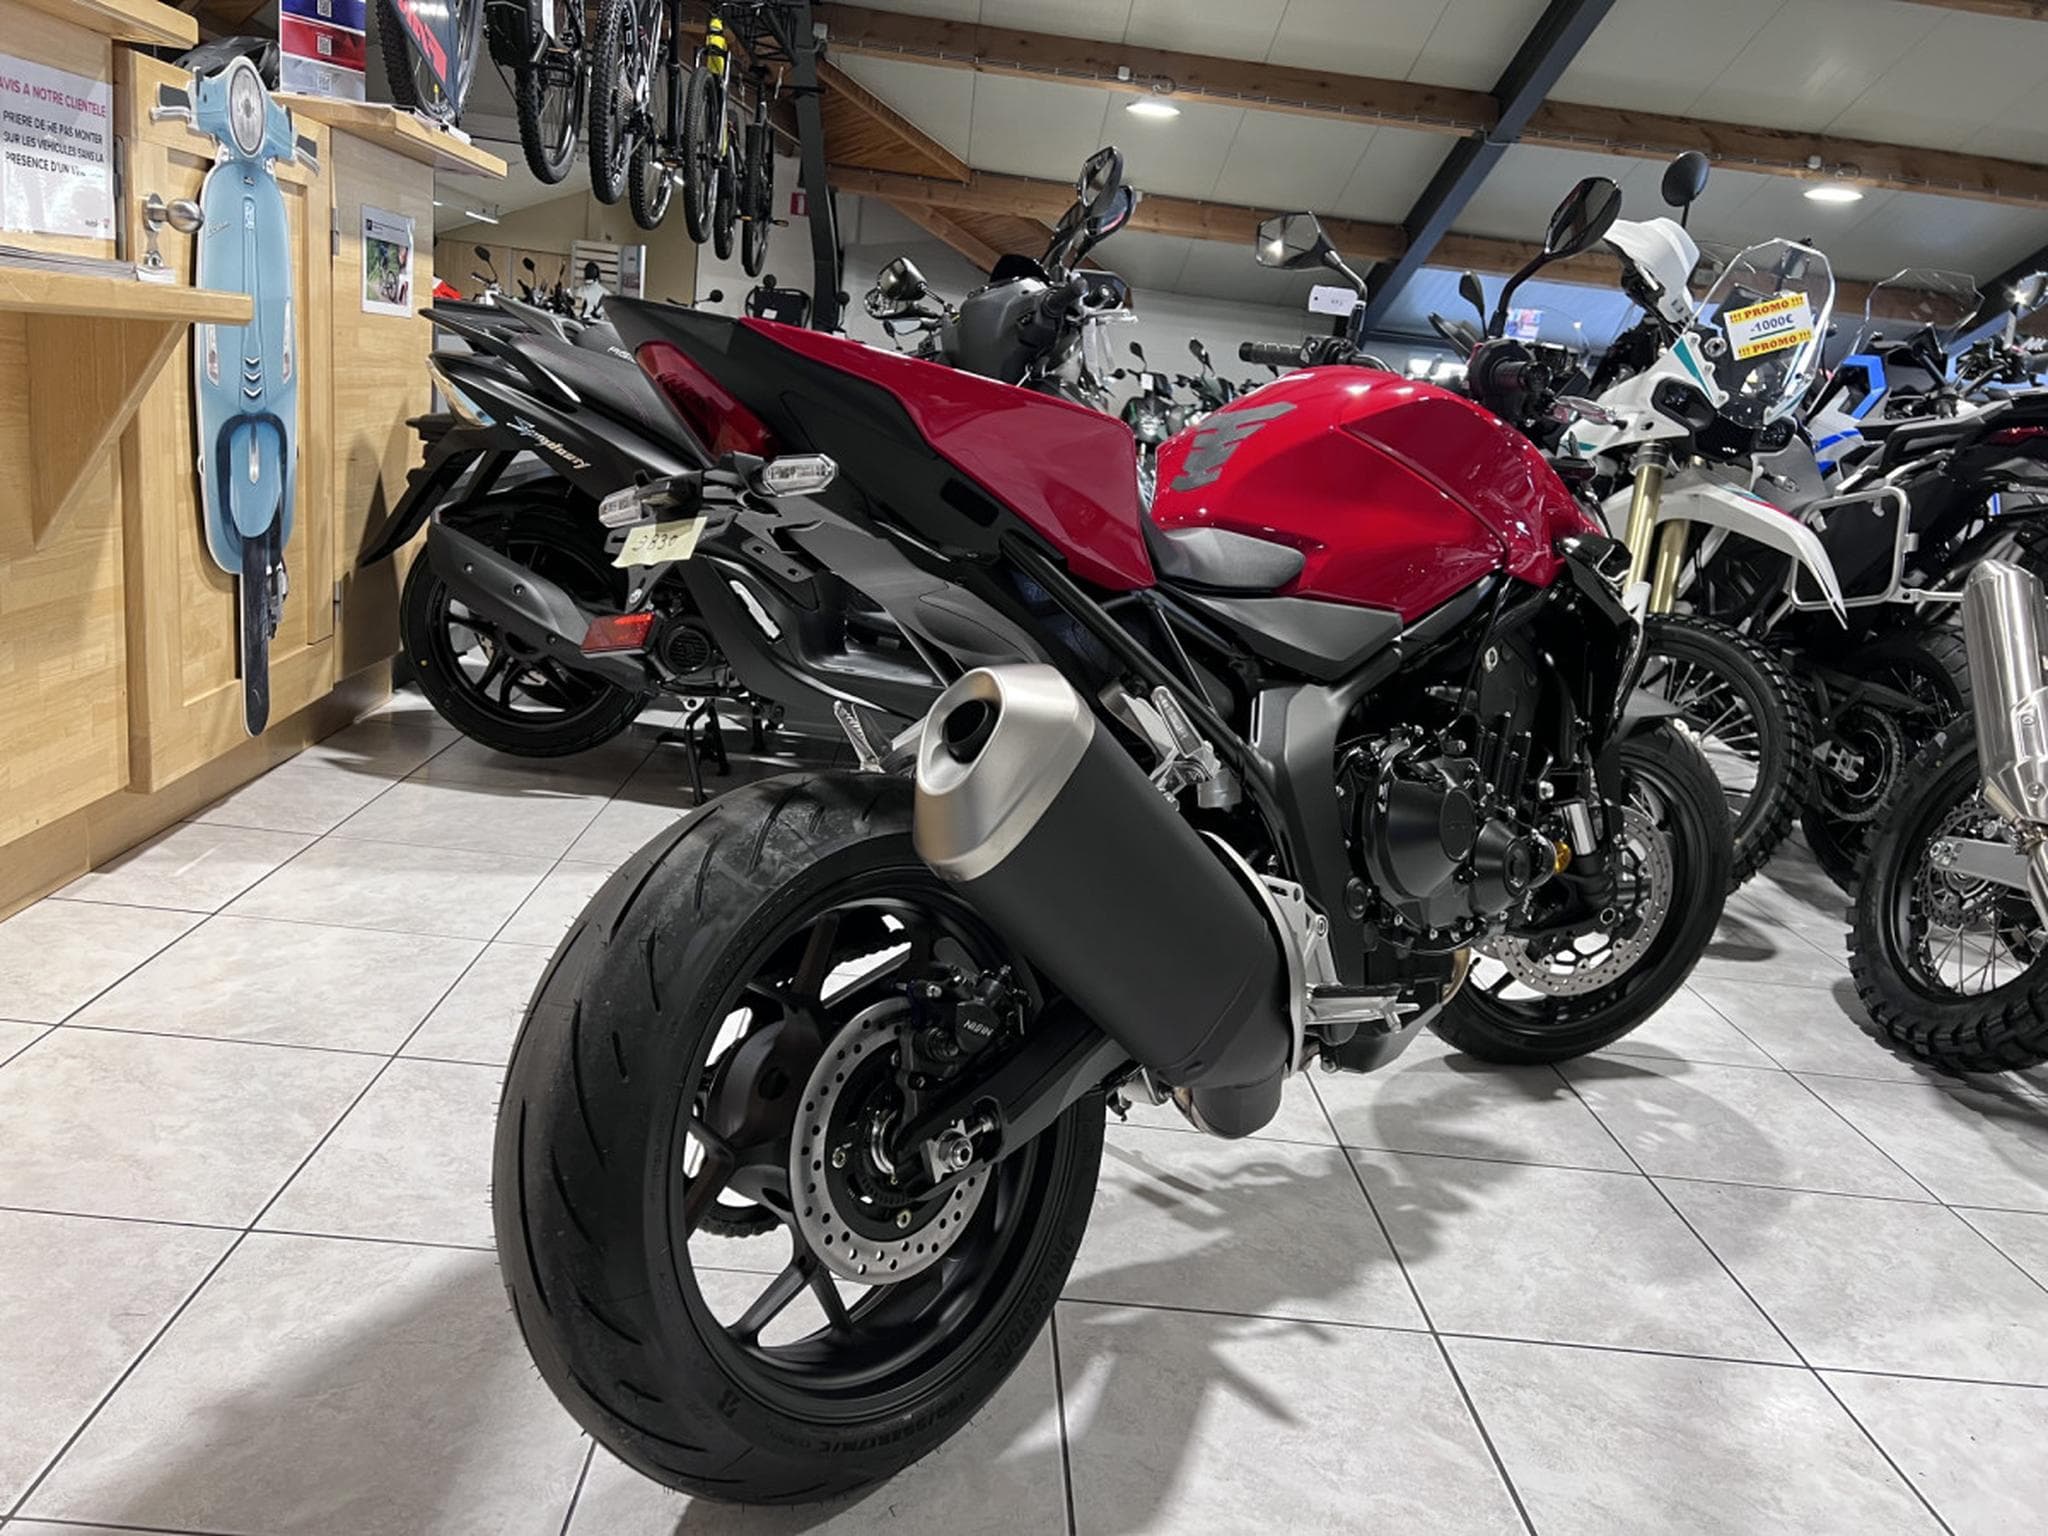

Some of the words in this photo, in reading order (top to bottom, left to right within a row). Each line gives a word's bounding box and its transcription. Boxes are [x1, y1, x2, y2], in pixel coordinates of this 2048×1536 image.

[23, 83, 31, 97] A
[32, 86, 64, 106] NOTRE
[65, 95, 107, 118] CLIENTELE
[3, 110, 33, 128] PRIERE
[34, 117, 46, 131] DE
[59, 123, 74, 138] PAS
[74, 128, 103, 145] MONTER
[3, 131, 20, 144] SUR
[22, 135, 37, 148] LES
[37, 137, 77, 157] VEHICULES
[77, 147, 95, 161] SANS
[95, 153, 104, 164] LA
[5, 151, 50, 172] PRESENCE
[50, 160, 70, 174] D'UN
[1743, 299, 1790, 320] PROMO
[1752, 334, 1798, 354] PROMO
